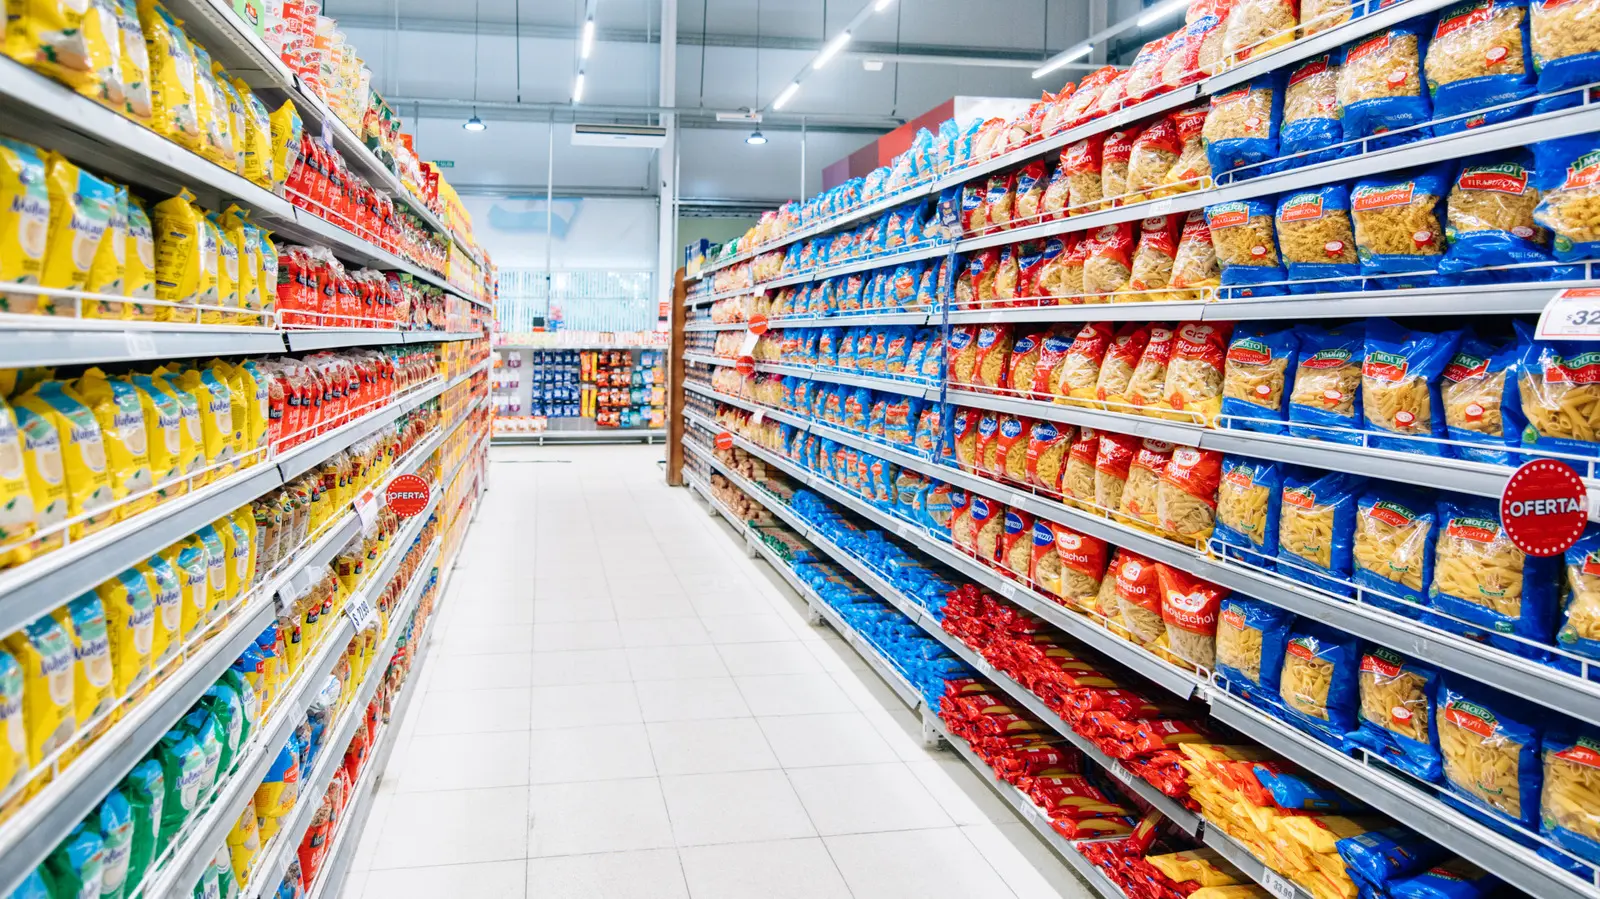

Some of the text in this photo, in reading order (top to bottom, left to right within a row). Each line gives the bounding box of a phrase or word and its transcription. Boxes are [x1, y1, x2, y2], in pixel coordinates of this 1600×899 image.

[1572, 310, 1600, 325] 32
[391, 491, 426, 500] OFERTA
[1510, 498, 1580, 517] OFERTA
[1163, 602, 1215, 625] Mostachol
[1461, 702, 1491, 719] MOLTO
[1265, 875, 1293, 899] $ 33.99
